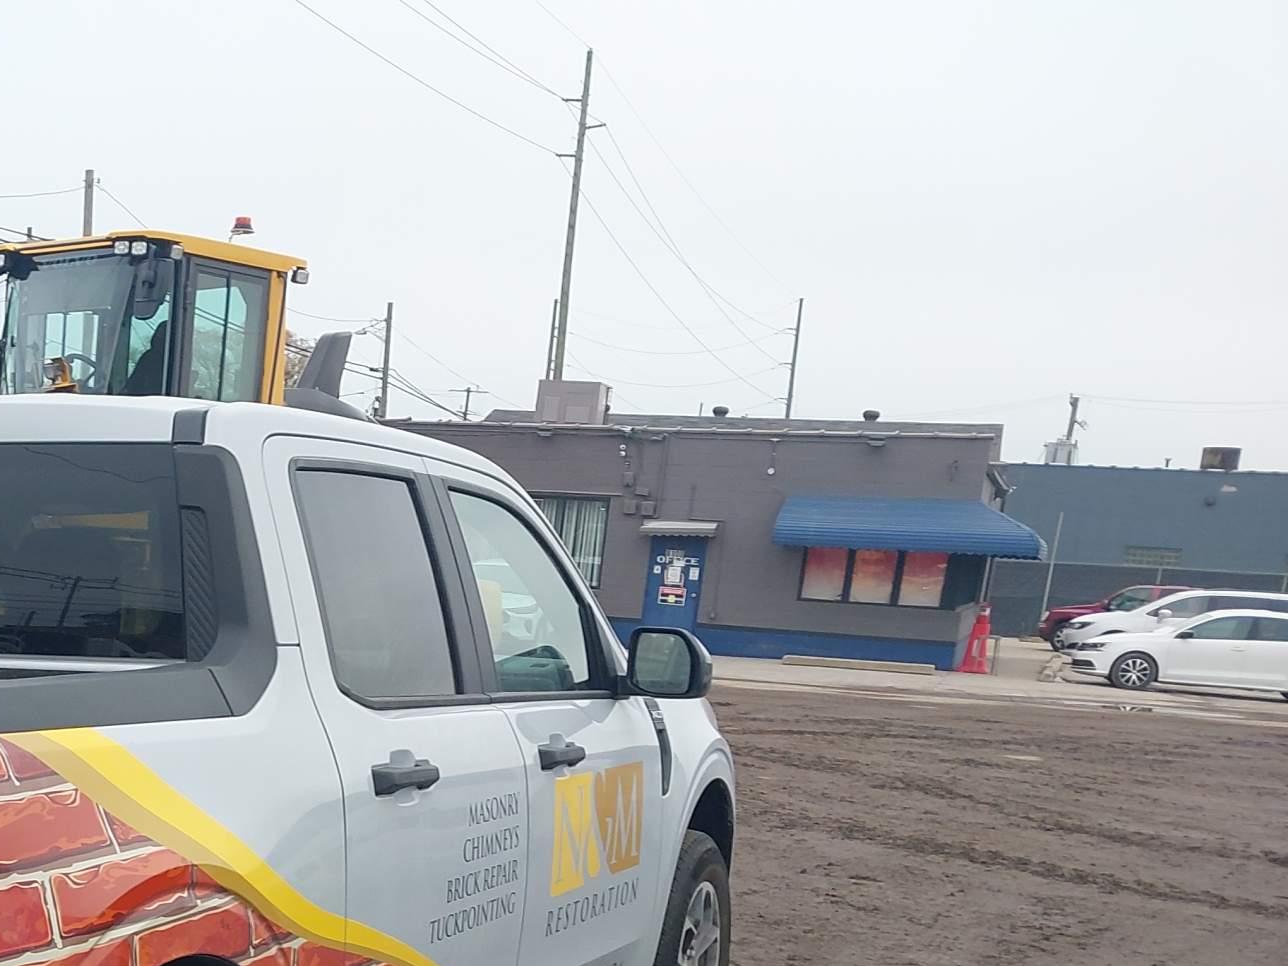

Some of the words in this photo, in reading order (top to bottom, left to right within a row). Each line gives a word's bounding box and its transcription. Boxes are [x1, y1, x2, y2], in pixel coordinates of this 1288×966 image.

[656, 555, 700, 566] OFCE
[468, 792, 520, 827] MASONRY
[463, 825, 520, 863] CHIMNEYS
[446, 870, 481, 904] BRICK
[482, 859, 519, 891] REPAIR
[429, 892, 516, 944] TUCKPOINTING
[545, 878, 640, 938] RESTORATION
